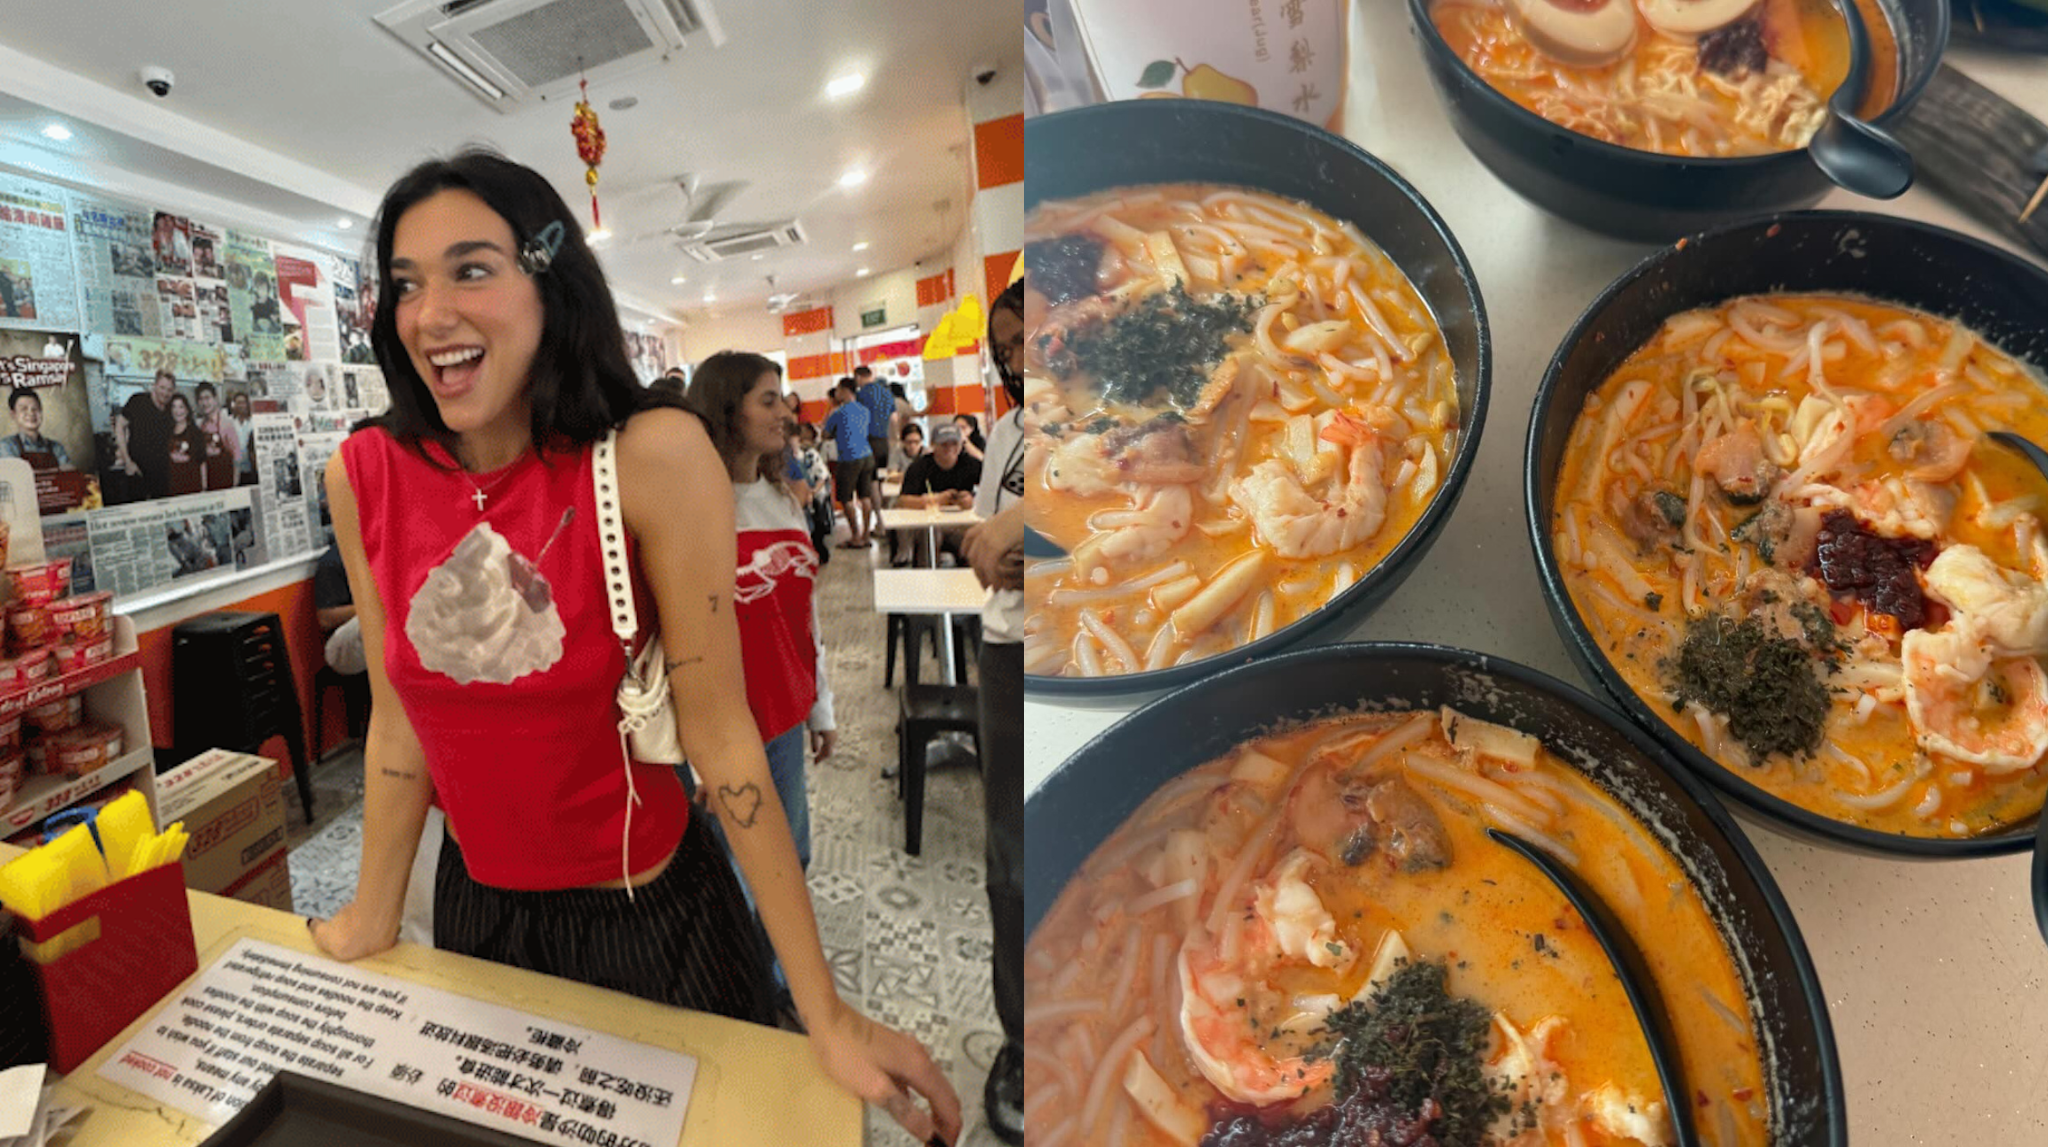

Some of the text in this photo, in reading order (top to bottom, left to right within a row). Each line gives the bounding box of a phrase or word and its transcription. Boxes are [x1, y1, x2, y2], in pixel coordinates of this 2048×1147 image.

[292, 963, 343, 985] consuming
[222, 960, 403, 1021] Keep the noodles and soup refrigerated
[341, 979, 361, 990] not
[361, 984, 379, 995] are
[378, 988, 402, 1000] you
[181, 995, 205, 1009] cook
[202, 1004, 237, 1020] please
[203, 985, 376, 1049] thoroughly the soup with the noodles
[314, 1003, 347, 1020] before
[166, 1029, 190, 1043] wish
[213, 1025, 231, 1038] the
[267, 1025, 311, 1045] separate
[189, 1036, 212, 1049] you
[230, 1031, 255, 1048] from
[253, 1038, 280, 1054] soup
[310, 1038, 338, 1055] soup
[212, 1046, 240, 1061] staff
[238, 1055, 260, 1067] our
[279, 1049, 298, 1063] the
[336, 1047, 354, 1060] all
[118, 1053, 158, 1073] cooked
[298, 1055, 345, 1077] separate
[351, 1054, 374, 1069] For
[153, 1068, 176, 1081] not
[171, 1073, 184, 1086] is
[227, 1071, 251, 1087] any
[182, 1078, 214, 1099] Laksa
[209, 1090, 227, 1102] of
